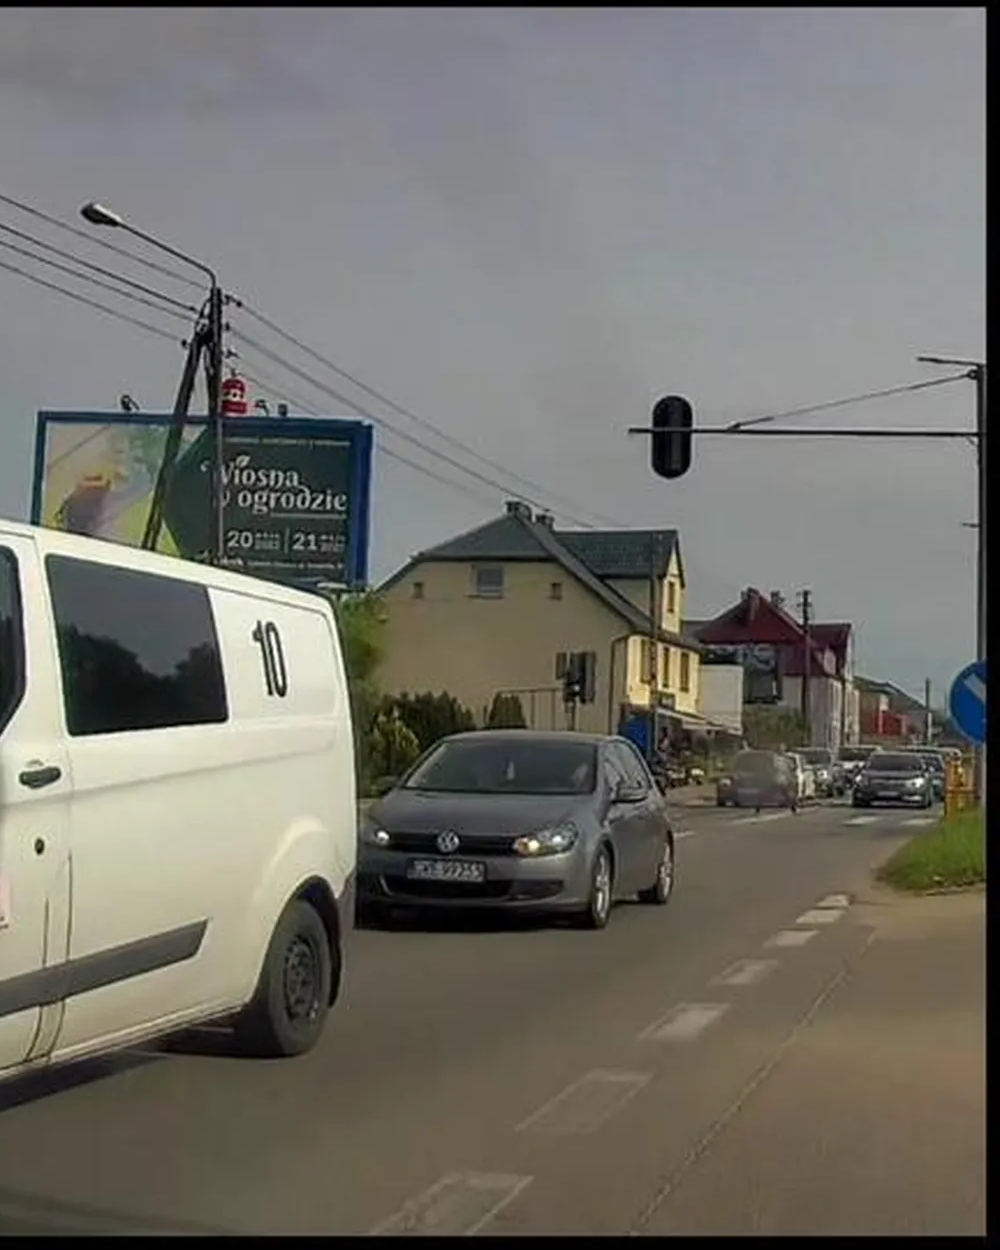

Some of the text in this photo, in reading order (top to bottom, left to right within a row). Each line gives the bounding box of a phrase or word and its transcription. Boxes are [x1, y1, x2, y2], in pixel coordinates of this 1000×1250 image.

[238, 486, 348, 515] ogrodzie
[227, 530, 253, 549] 20
[292, 532, 318, 551] 21
[252, 619, 287, 698] 10
